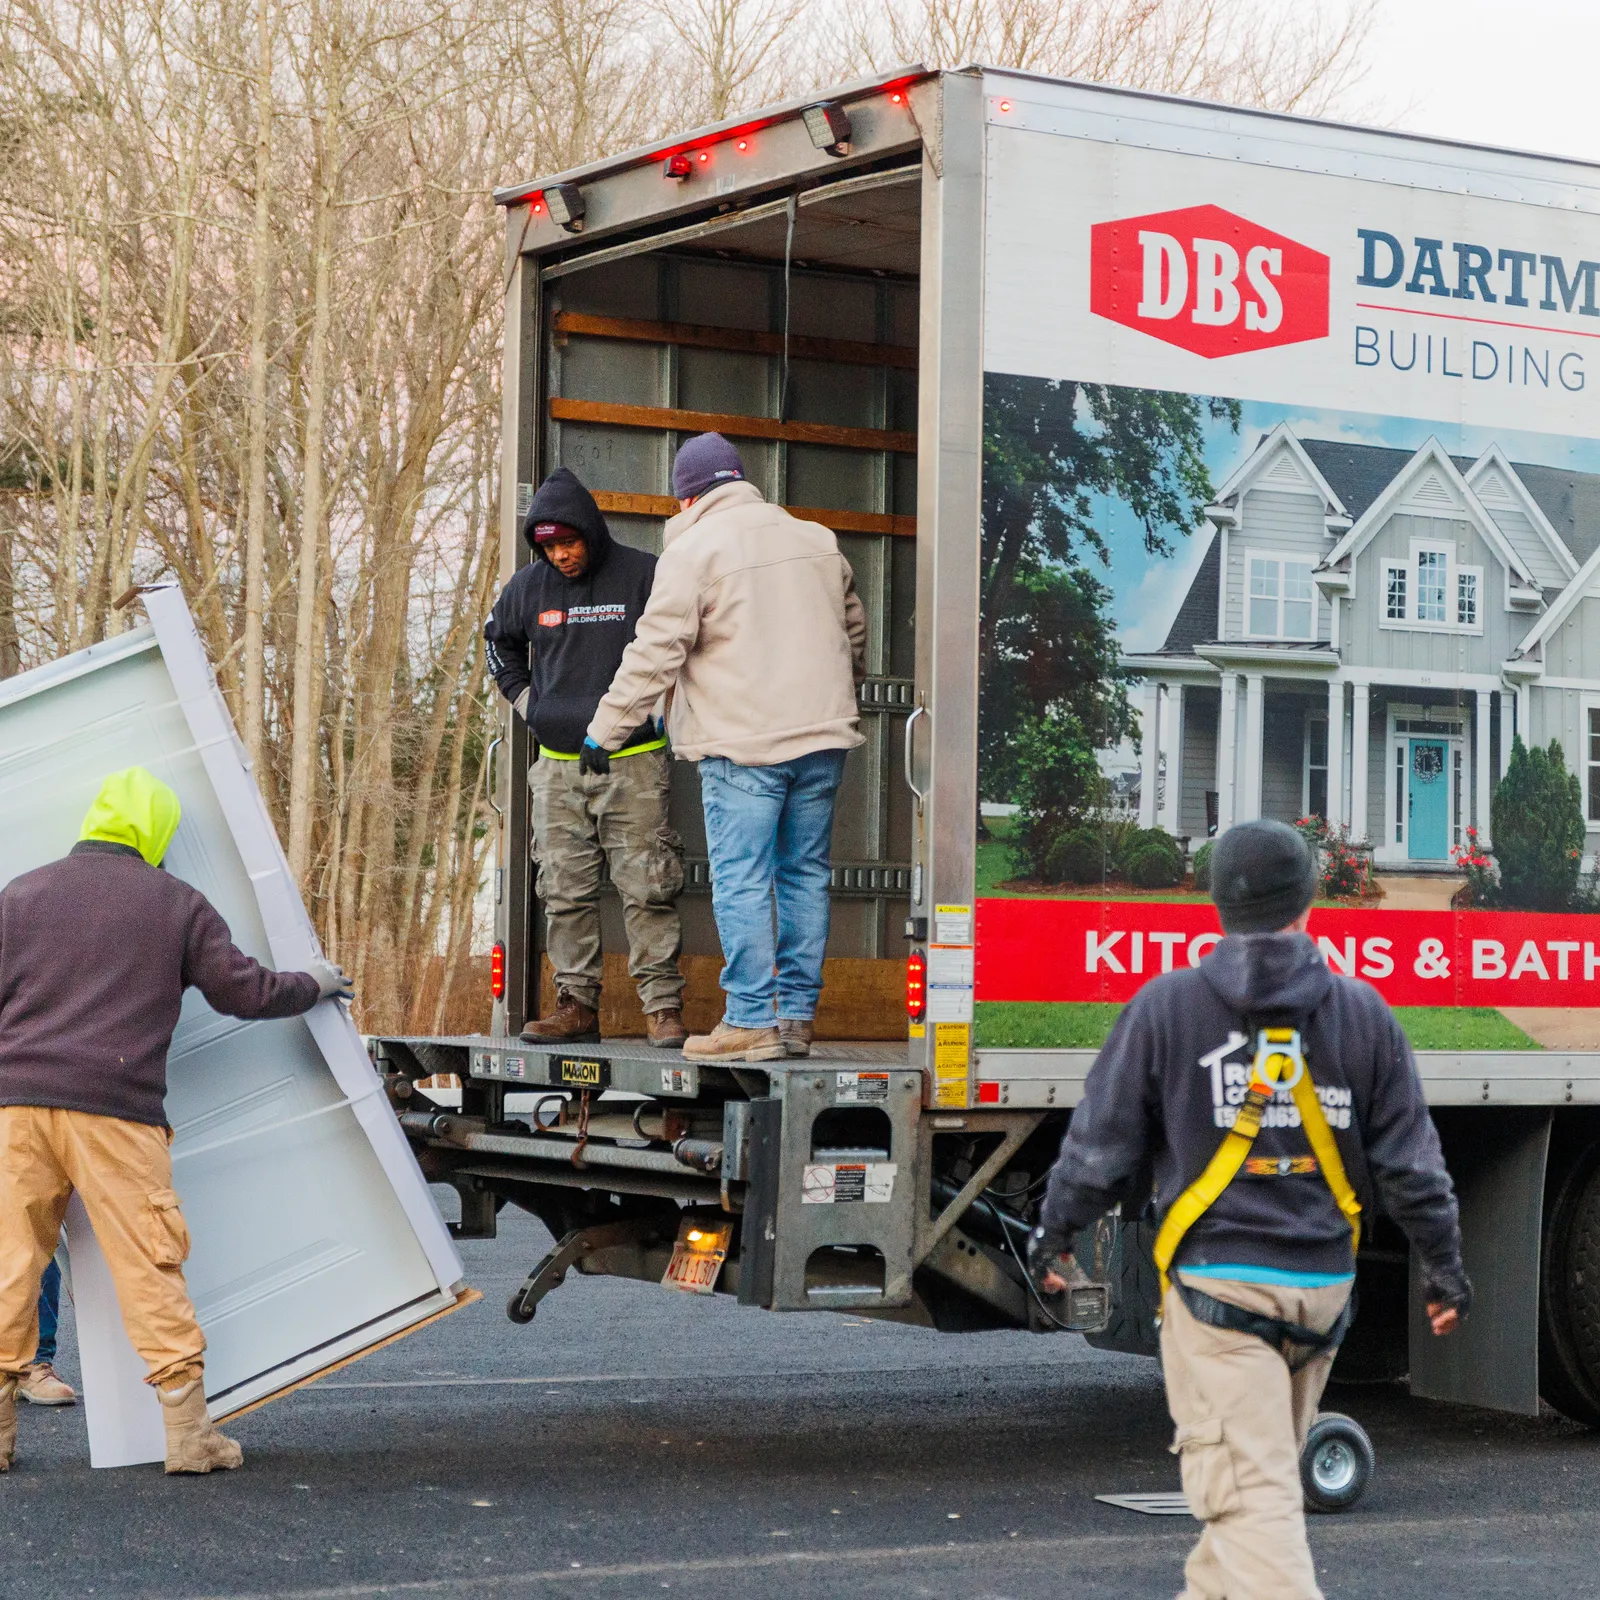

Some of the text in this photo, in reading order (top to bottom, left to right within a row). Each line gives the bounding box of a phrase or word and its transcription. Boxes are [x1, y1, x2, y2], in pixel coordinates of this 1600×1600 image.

[1138, 230, 1283, 333] DBS
[1356, 228, 1600, 317] DARTM
[1355, 325, 1585, 391] BUILDING
[543, 614, 560, 623] DBS
[567, 614, 626, 625] BUILDING SUPPLY
[568, 604, 626, 615] DARTMOUTH
[1085, 930, 1395, 979] KITCNS
[1413, 937, 1451, 979] &
